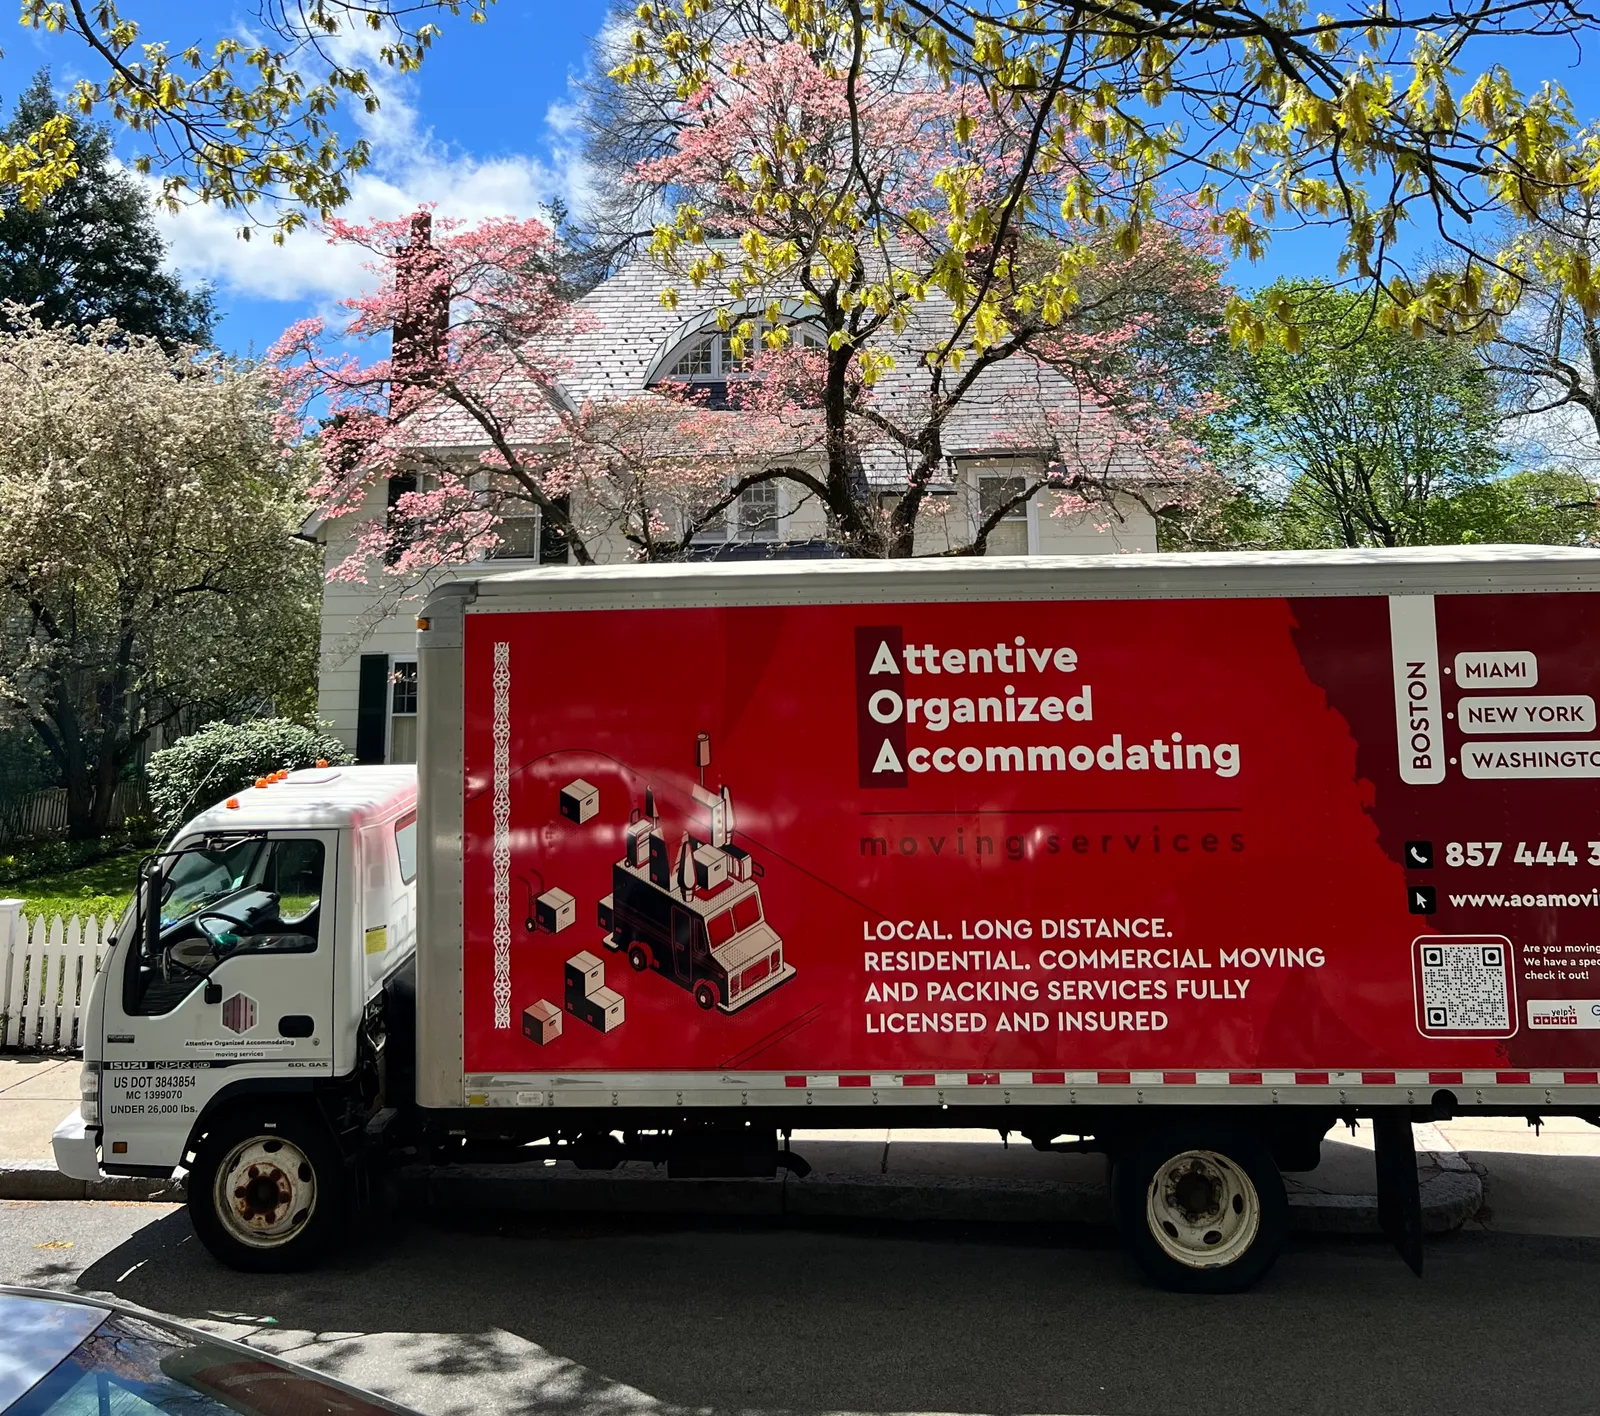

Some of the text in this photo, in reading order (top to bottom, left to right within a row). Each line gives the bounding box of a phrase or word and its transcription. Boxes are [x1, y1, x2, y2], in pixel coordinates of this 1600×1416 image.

[869, 635, 1078, 675] Attentive
[1465, 662, 1526, 678] MIAMI
[868, 685, 1093, 732] Organized
[1406, 661, 1432, 770] BOSTON
[1468, 706, 1585, 723] NEW YORK
[872, 732, 1241, 778] Accommodating
[860, 825, 1245, 860] moving services
[1445, 842, 1503, 867] 857
[1513, 841, 1578, 866] 444
[1449, 888, 1600, 907] www.aoamovi
[863, 918, 1173, 941] LOCAL. LONG DISTANCE.
[1523, 944, 1540, 952] Are
[1543, 945, 1561, 954] you
[864, 947, 1326, 972] RESIDENTIAL. COMMERCIAL MOVING
[1524, 957, 1540, 966] We
[1543, 957, 1567, 966] have
[1524, 970, 1589, 979] check it out!
[864, 978, 1250, 1003] AND PACKING SERVICES FULLY
[1551, 1007, 1569, 1016] yelp
[866, 1010, 1168, 1034] LICENSED AND INSURED
[214, 1039, 245, 1047] Organized
[110, 1061, 148, 1070] ISUZU
[114, 1076, 196, 1088] US DOT 3843854
[126, 1090, 183, 1099] MC 1399070
[110, 1104, 198, 1115] UNDER 26,000 lbs.
